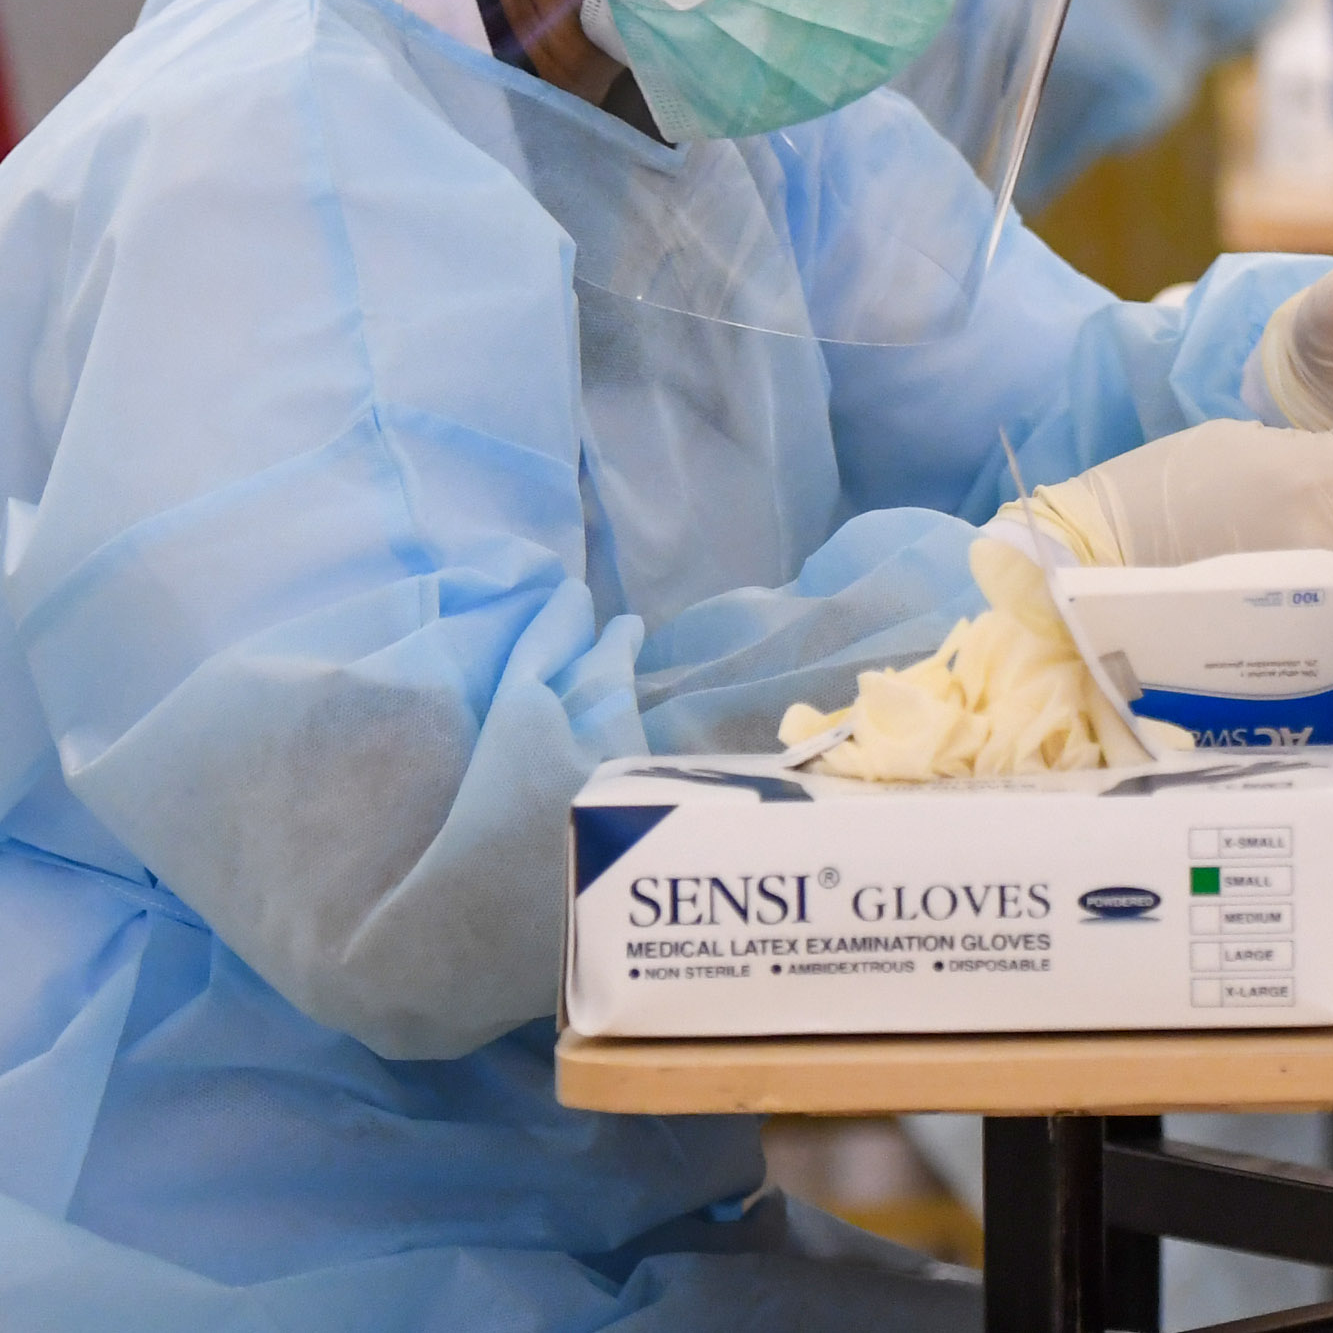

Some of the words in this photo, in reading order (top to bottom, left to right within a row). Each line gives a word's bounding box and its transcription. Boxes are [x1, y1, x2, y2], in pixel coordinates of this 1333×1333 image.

[1292, 592, 1320, 605] 100
[1223, 876, 1272, 888] SMALL
[851, 882, 1051, 922] GLOVES
[1223, 912, 1282, 925] MEDIUM
[626, 940, 724, 959] MEDICAL
[730, 938, 799, 957] LATEX
[805, 935, 955, 955] EXAMINATION
[960, 933, 1051, 952] GLOVES
[1224, 949, 1274, 962] LARGE
[644, 967, 680, 981] NON
[685, 964, 750, 979] STERILE
[787, 960, 915, 976] AMBIDEXTROUS
[948, 958, 1052, 973] DISPOSABLE
[1224, 986, 1289, 999] X-LARGE
